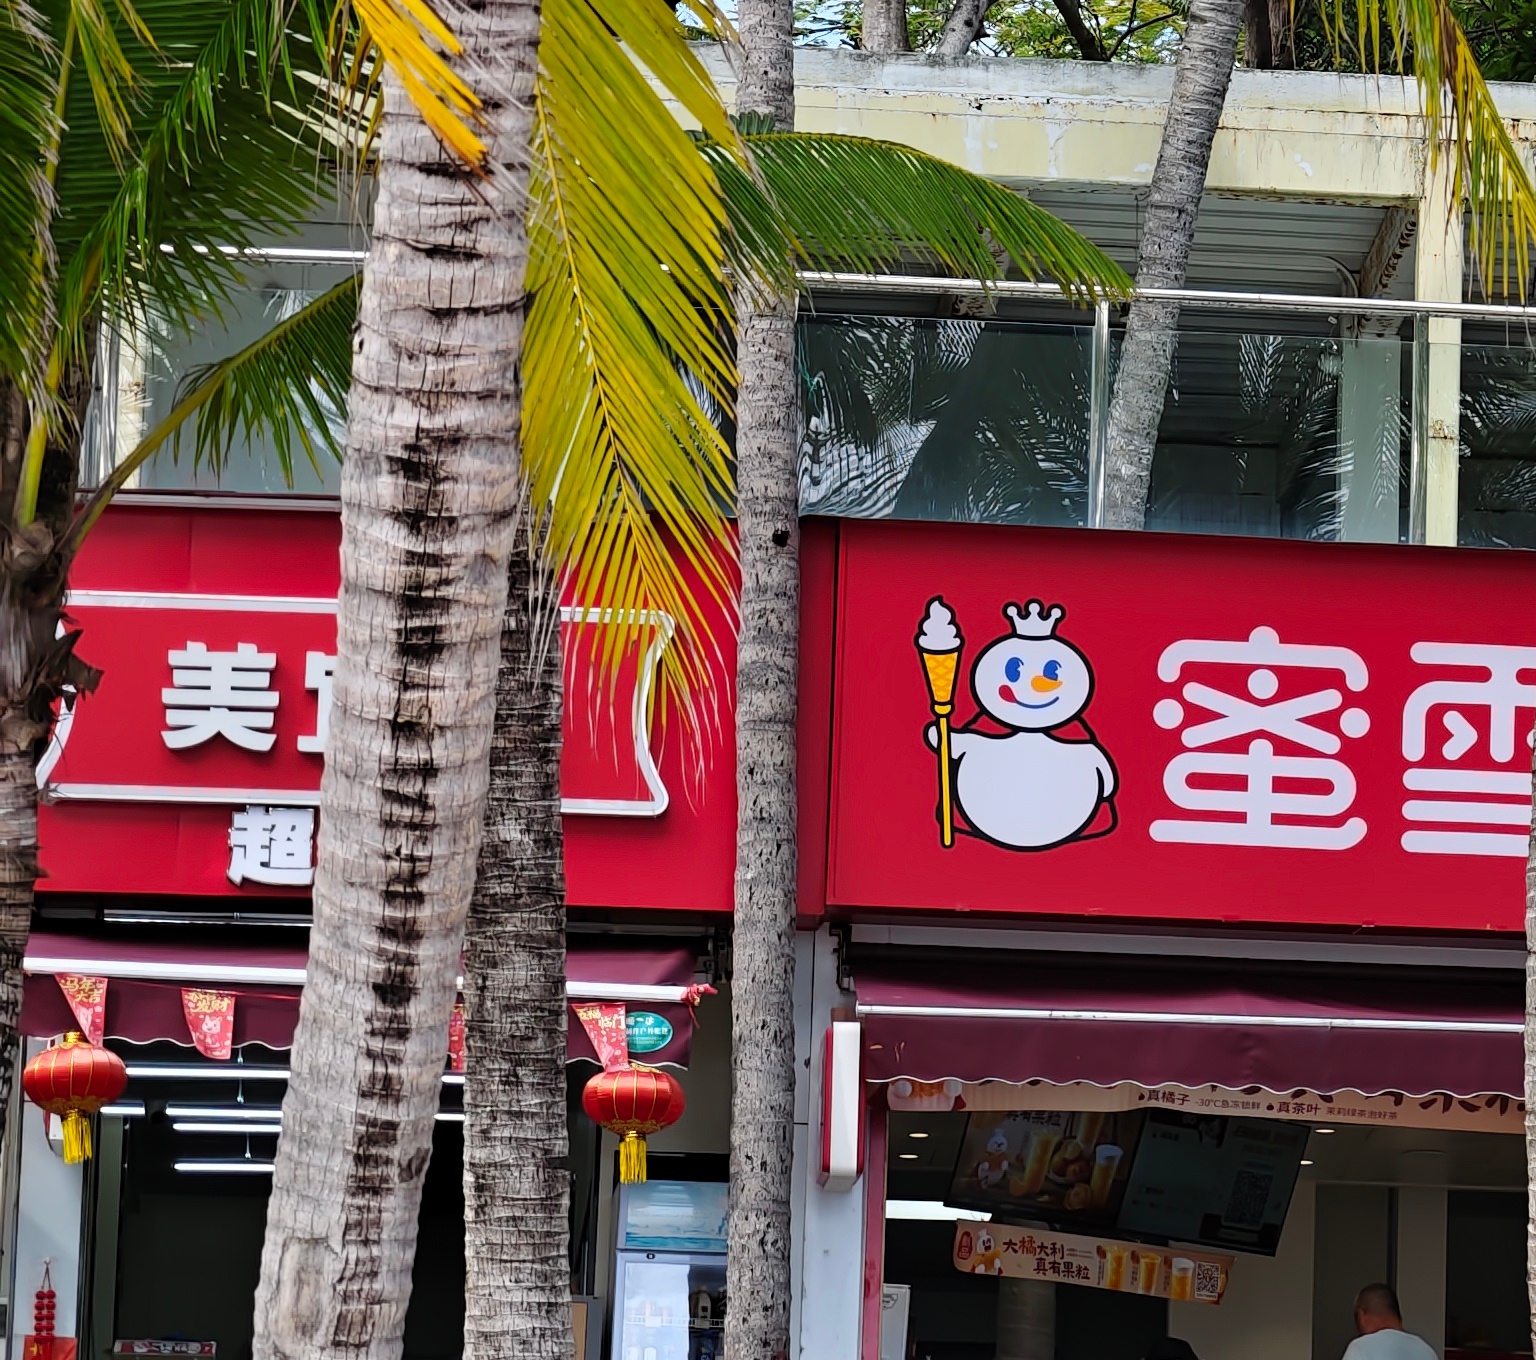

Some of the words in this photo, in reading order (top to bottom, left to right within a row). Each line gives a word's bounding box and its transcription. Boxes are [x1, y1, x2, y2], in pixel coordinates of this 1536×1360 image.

[226, 805, 315, 887] 超
[1276, 1101, 1321, 1117] 真茶叶
[1003, 1235, 1065, 1260] 大橘大利
[1033, 1256, 1091, 1281] 真有果粒
